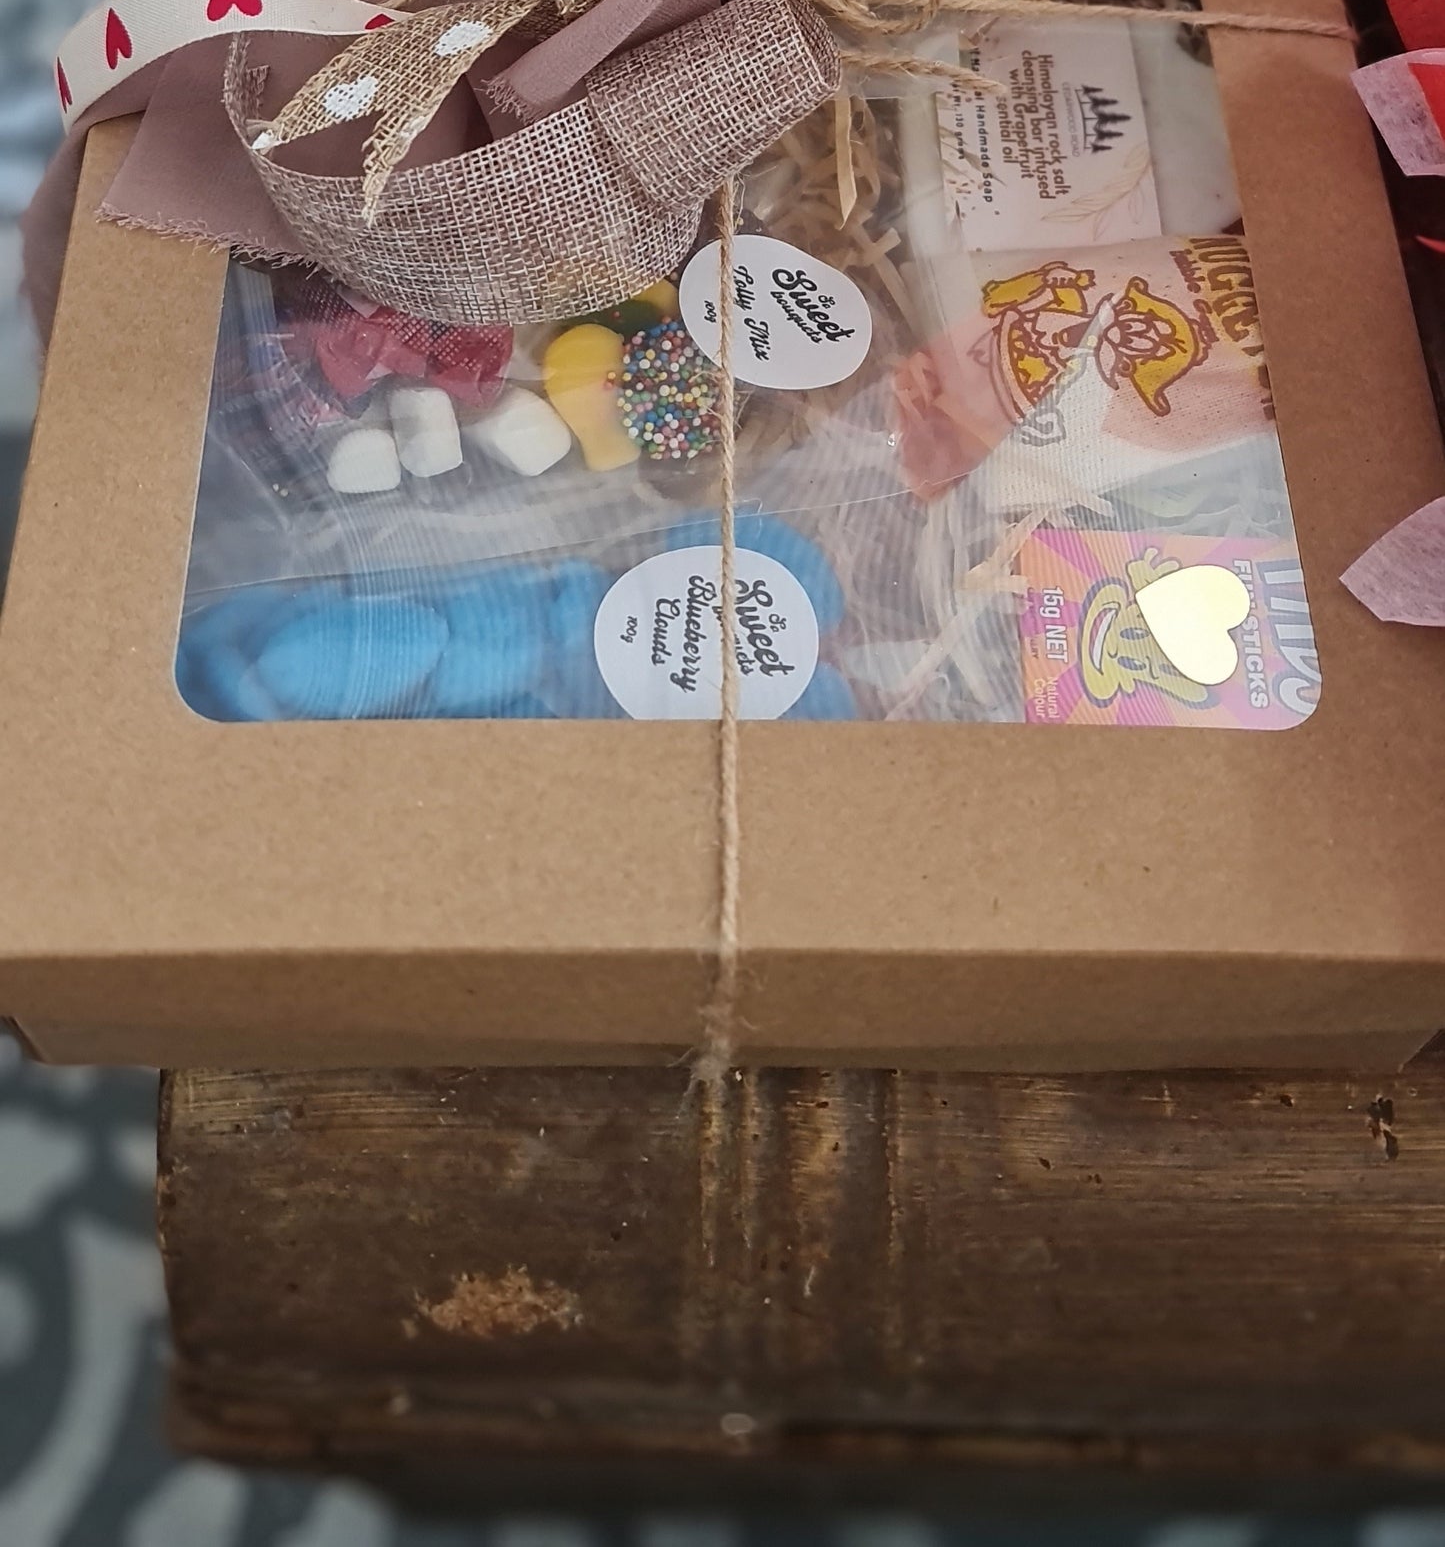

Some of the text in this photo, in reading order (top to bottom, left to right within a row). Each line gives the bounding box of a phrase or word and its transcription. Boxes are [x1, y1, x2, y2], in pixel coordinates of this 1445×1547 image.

[975, 105, 990, 168] Handmade
[1002, 147, 1019, 164] oil
[1008, 69, 1035, 179] with Grapefruit
[1021, 50, 1057, 200] cleansing bar infused
[1037, 54, 1072, 195] Himalayan rock salt
[982, 172, 994, 203] Soap
[744, 317, 770, 361] Mix
[770, 291, 823, 344] bouquets
[772, 268, 855, 342] Sweet
[620, 615, 638, 644] 100g
[651, 598, 681, 667] Clouds
[670, 575, 716, 693] Blueberry
[734, 579, 795, 677] Sweet
[1040, 586, 1068, 663] 15g NET
[1241, 616, 1270, 709] STICKS
[1034, 678, 1046, 719] Colour
[1048, 676, 1060, 719] Natural
